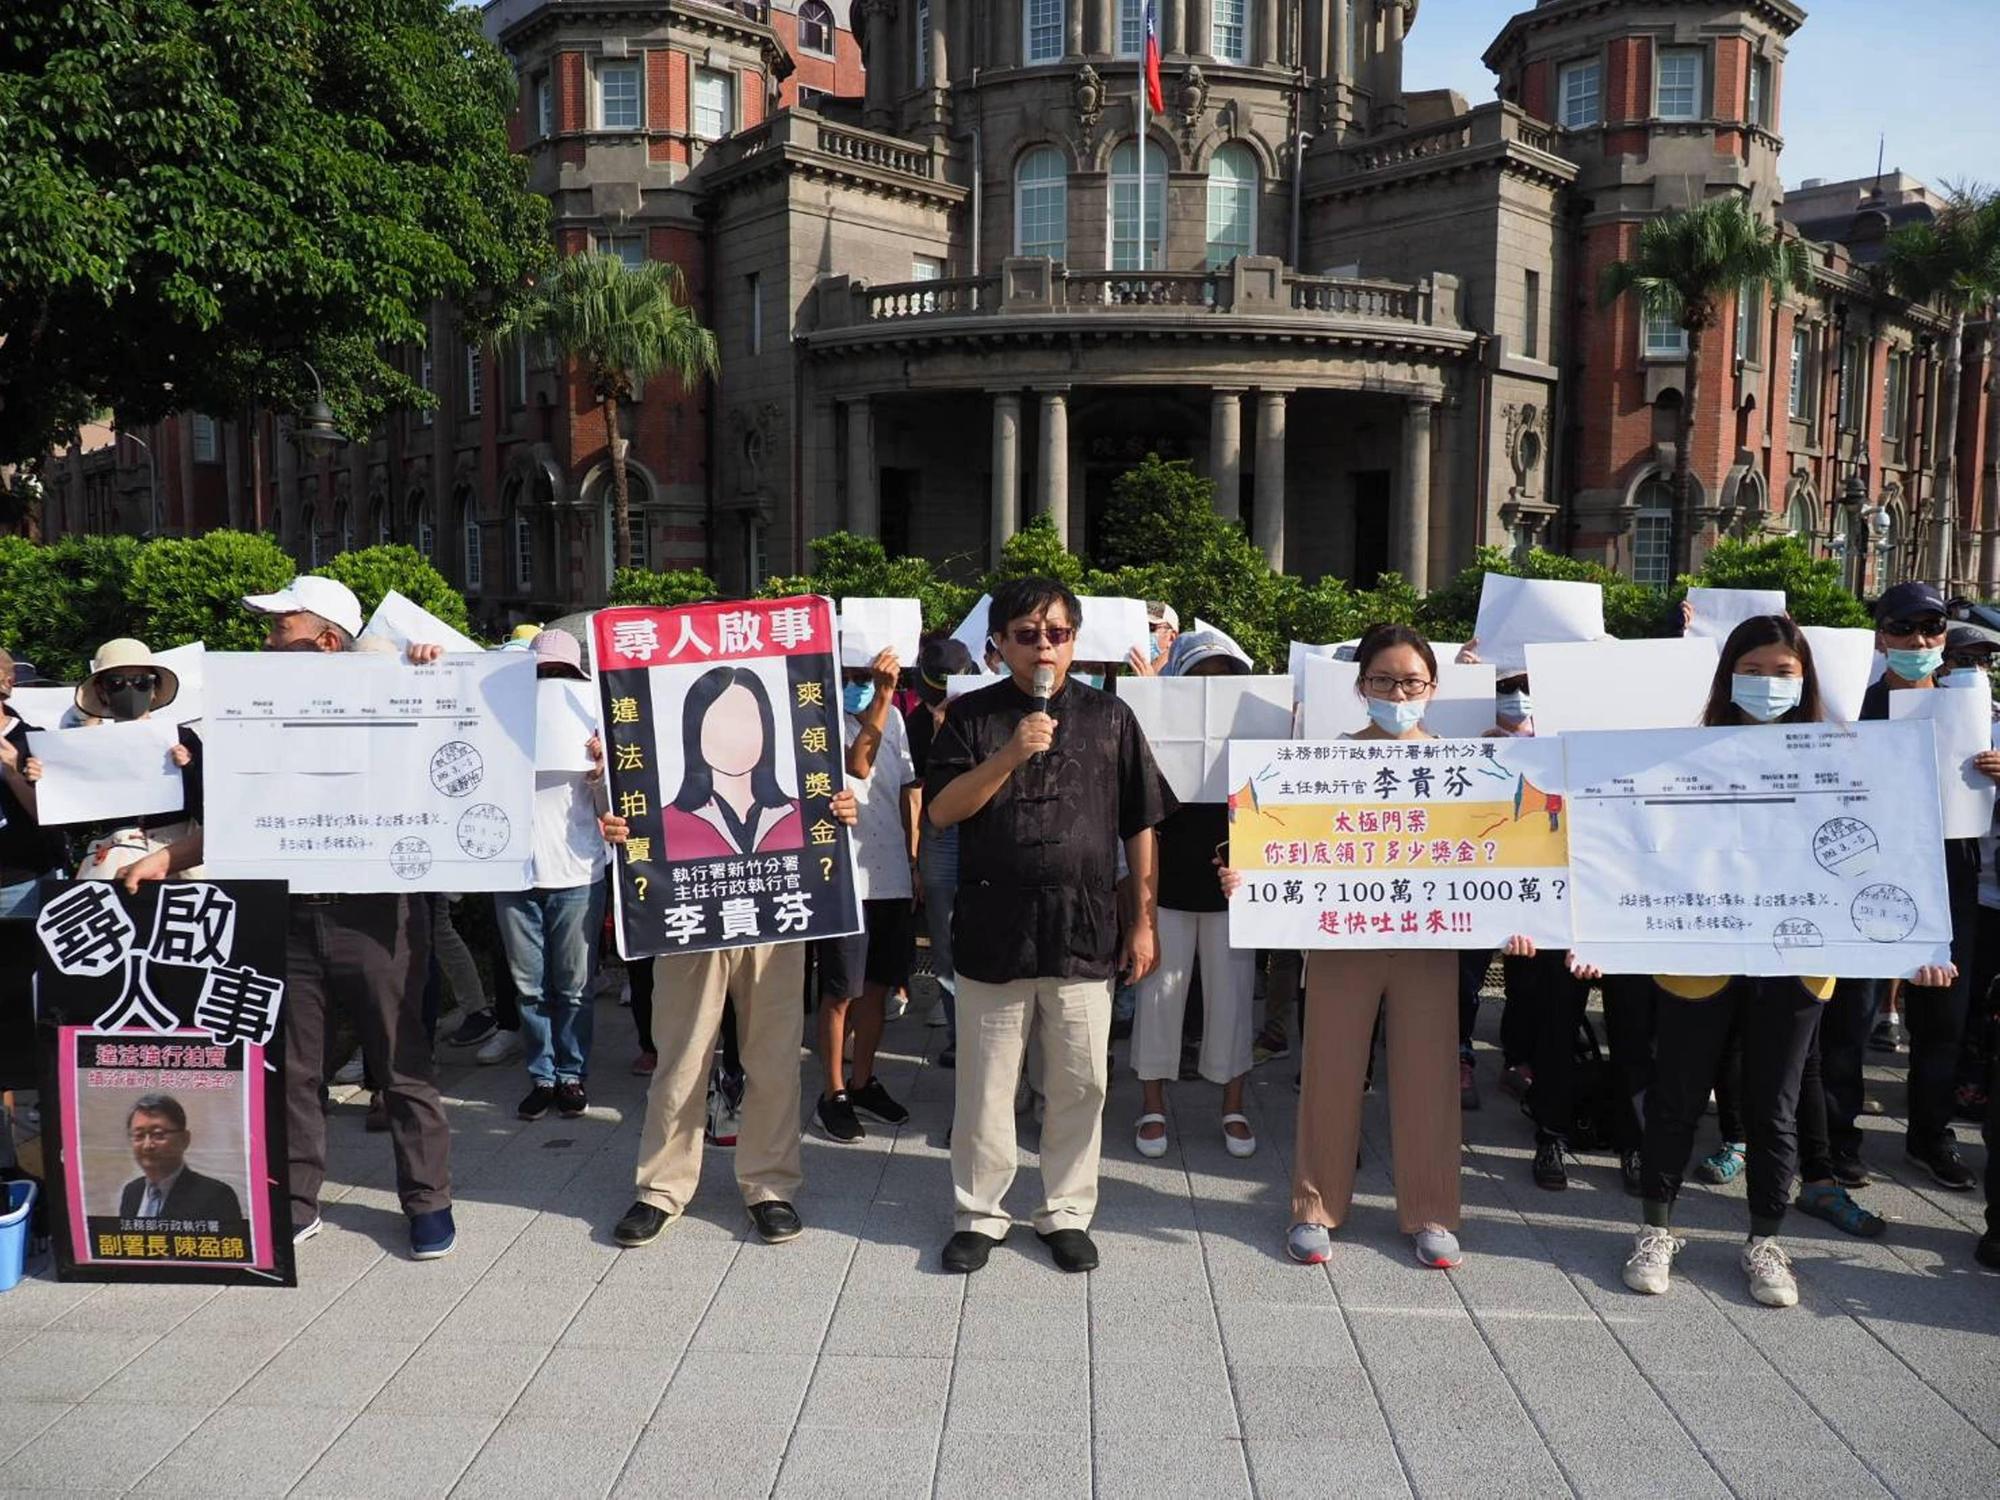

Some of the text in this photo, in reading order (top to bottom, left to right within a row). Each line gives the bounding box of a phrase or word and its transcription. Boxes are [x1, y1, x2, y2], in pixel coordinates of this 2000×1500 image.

[612, 606, 814, 660] 尋人啟事
[1277, 744, 1497, 760] 法務部行政執行署新竹分署
[796, 681, 837, 882] 爽領獎金？
[1279, 766, 1473, 799] 主任執行官 李貴芬
[611, 697, 652, 902] 違法拍賣？
[1333, 809, 1427, 833] 太極門案
[1264, 839, 1497, 866] 你到底領了多少獎金？
[672, 855, 799, 883] 執行署新竹分署
[674, 873, 801, 902] 主任行政執行官
[1247, 877, 1566, 905] 10萬？100萬？1000萬？
[664, 893, 814, 945] 李貴芬
[1317, 910, 1472, 935] 趕快吐出來!!!
[95, 1043, 227, 1069] 違法強行拍賣
[120, 1218, 219, 1233] 法務部行政執行署
[98, 1234, 245, 1259] 副署長 陳盈錦
